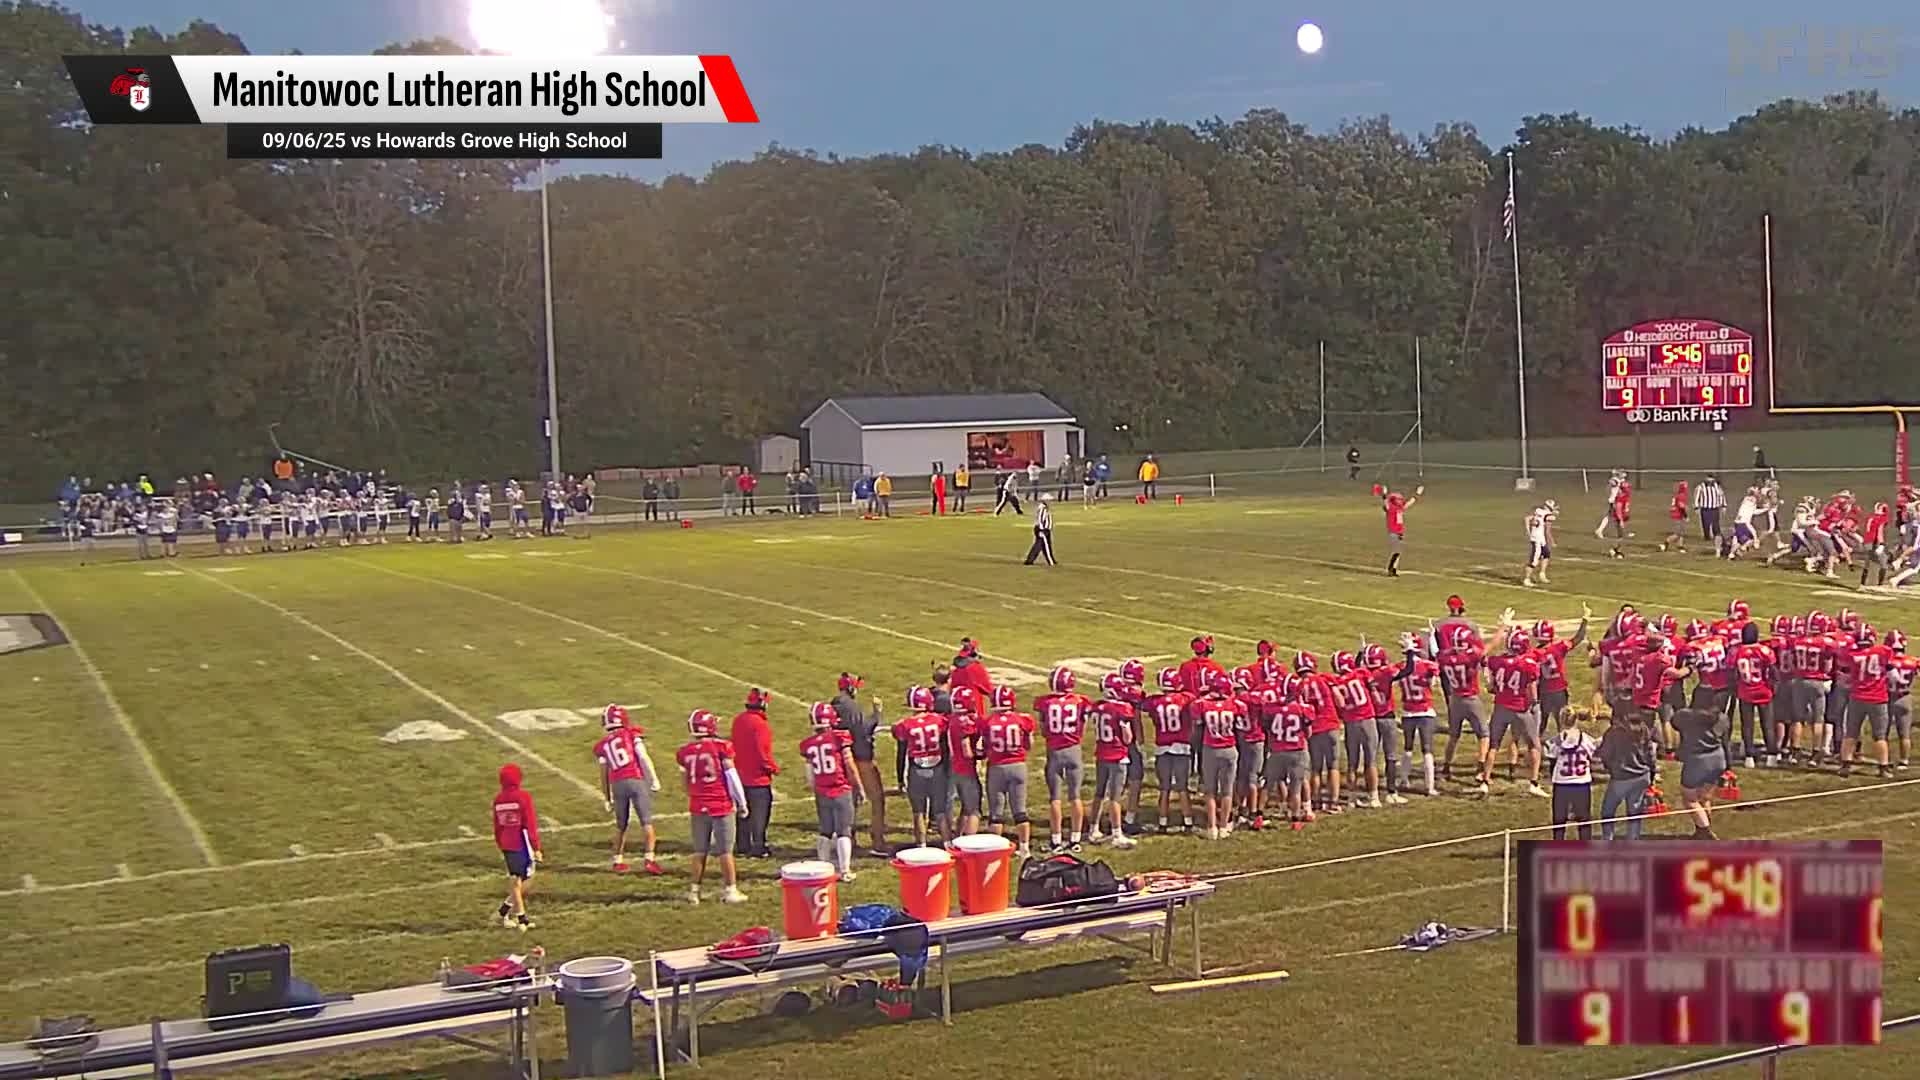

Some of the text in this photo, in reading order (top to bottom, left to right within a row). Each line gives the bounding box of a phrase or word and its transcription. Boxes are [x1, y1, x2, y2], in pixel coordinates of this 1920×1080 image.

[1616, 357, 1628, 376] 0
[1662, 343, 1702, 364] 5:46
[1737, 354, 1750, 373] 0
[1621, 389, 1634, 407] 9
[1702, 386, 1714, 405] 9
[1654, 407, 1728, 423] BankFirst
[1048, 704, 1078, 733] 82
[1156, 704, 1181, 732] 18
[1271, 713, 1300, 743] 42
[909, 724, 941, 753] 33
[603, 737, 630, 770] 16
[807, 743, 837, 775] 36
[685, 753, 717, 784] 73
